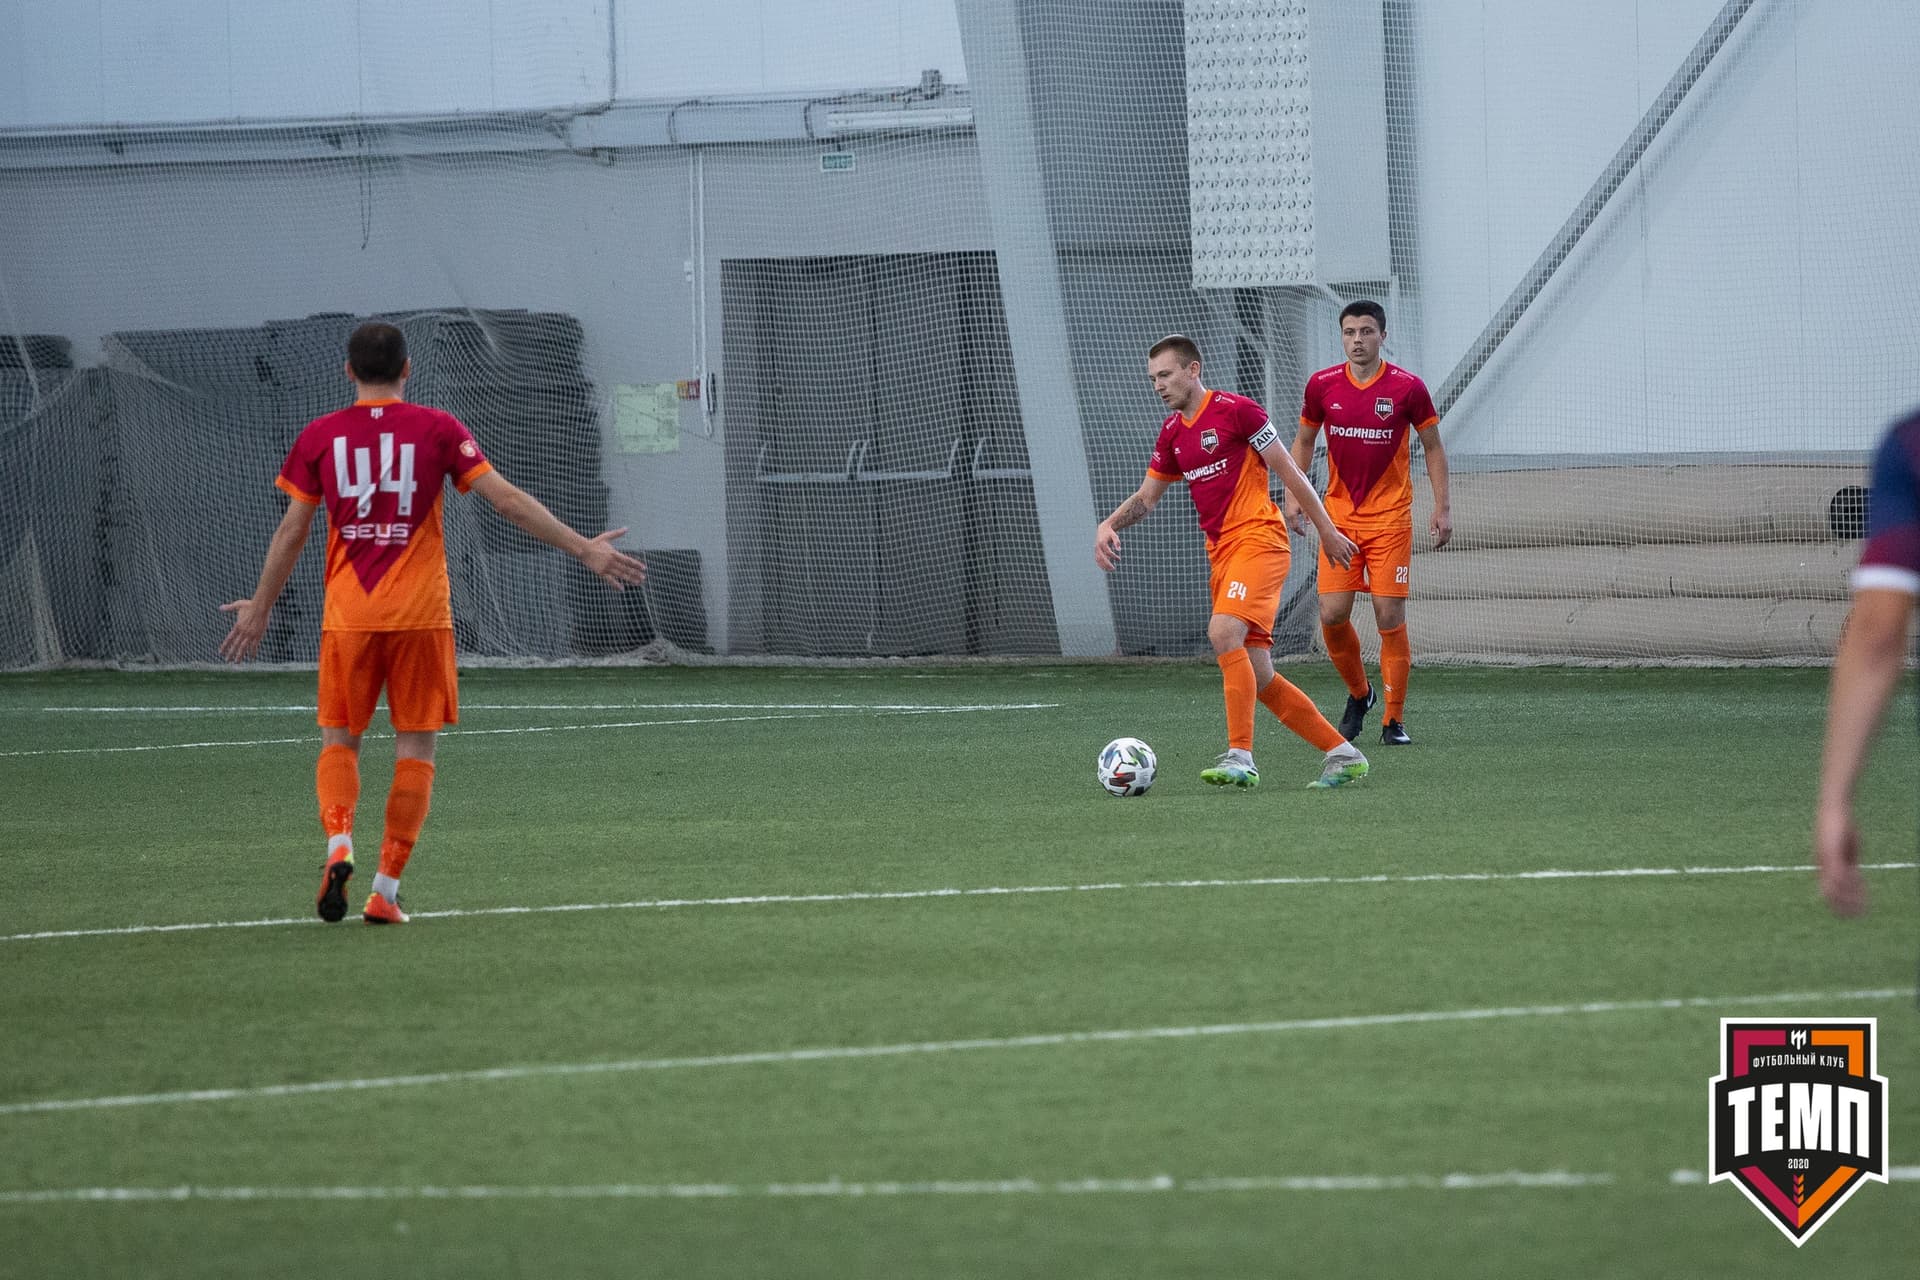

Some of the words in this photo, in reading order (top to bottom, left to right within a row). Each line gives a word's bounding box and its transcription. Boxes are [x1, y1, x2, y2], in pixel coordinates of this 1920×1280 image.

[333, 432, 417, 518] 44
[341, 522, 409, 540] SEUS
[1395, 566, 1408, 584] 22
[1226, 580, 1247, 601] 24
